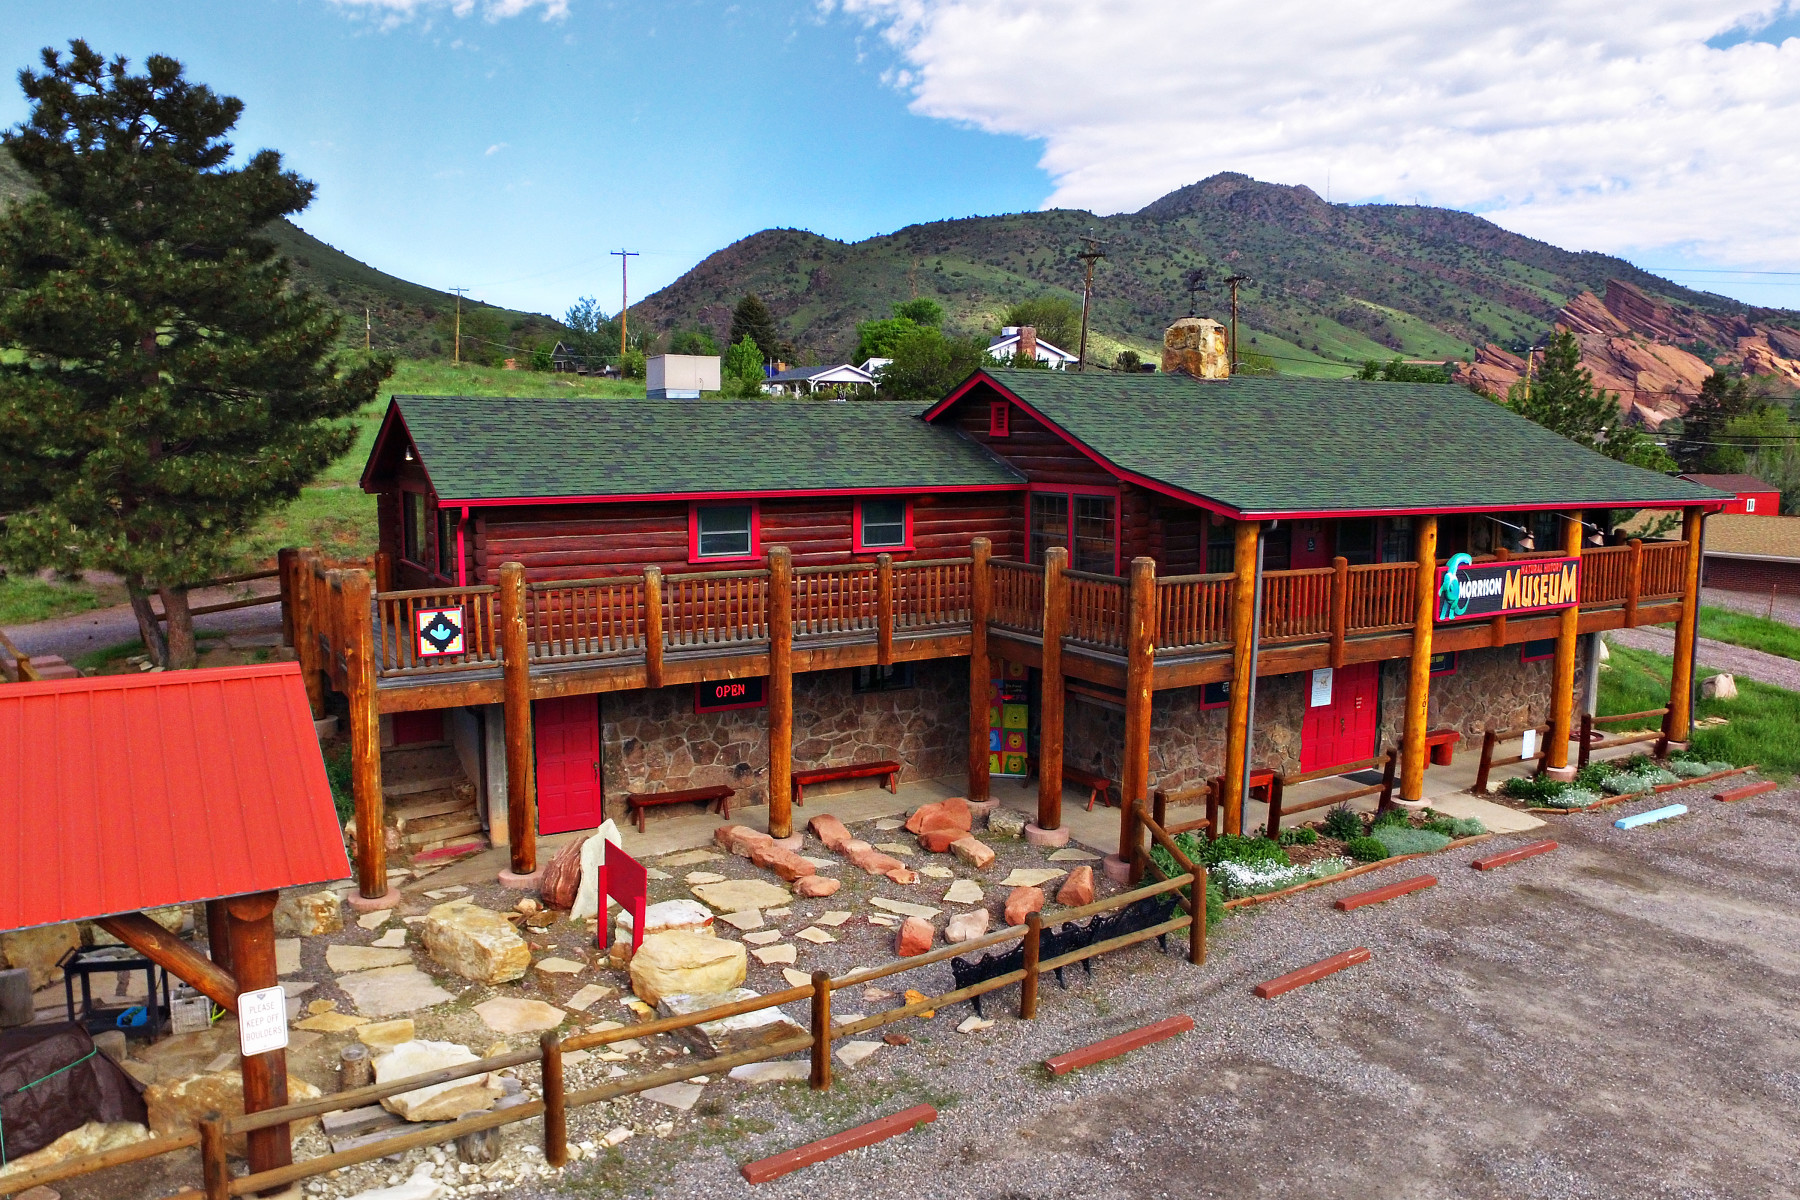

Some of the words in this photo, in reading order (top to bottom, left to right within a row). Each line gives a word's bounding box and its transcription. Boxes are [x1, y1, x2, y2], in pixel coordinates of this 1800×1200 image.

[1520, 563, 1543, 575] NATURAL
[1543, 562, 1563, 574] HISTORY
[1458, 577, 1502, 599] MORRISON
[1502, 564, 1577, 609] MUSEUM
[715, 684, 745, 698] OPEN
[249, 1001, 275, 1014] PLEASE
[246, 1016, 264, 1028] KEEP
[266, 1013, 279, 1024] OFF
[245, 1025, 282, 1042] BOULDERS
